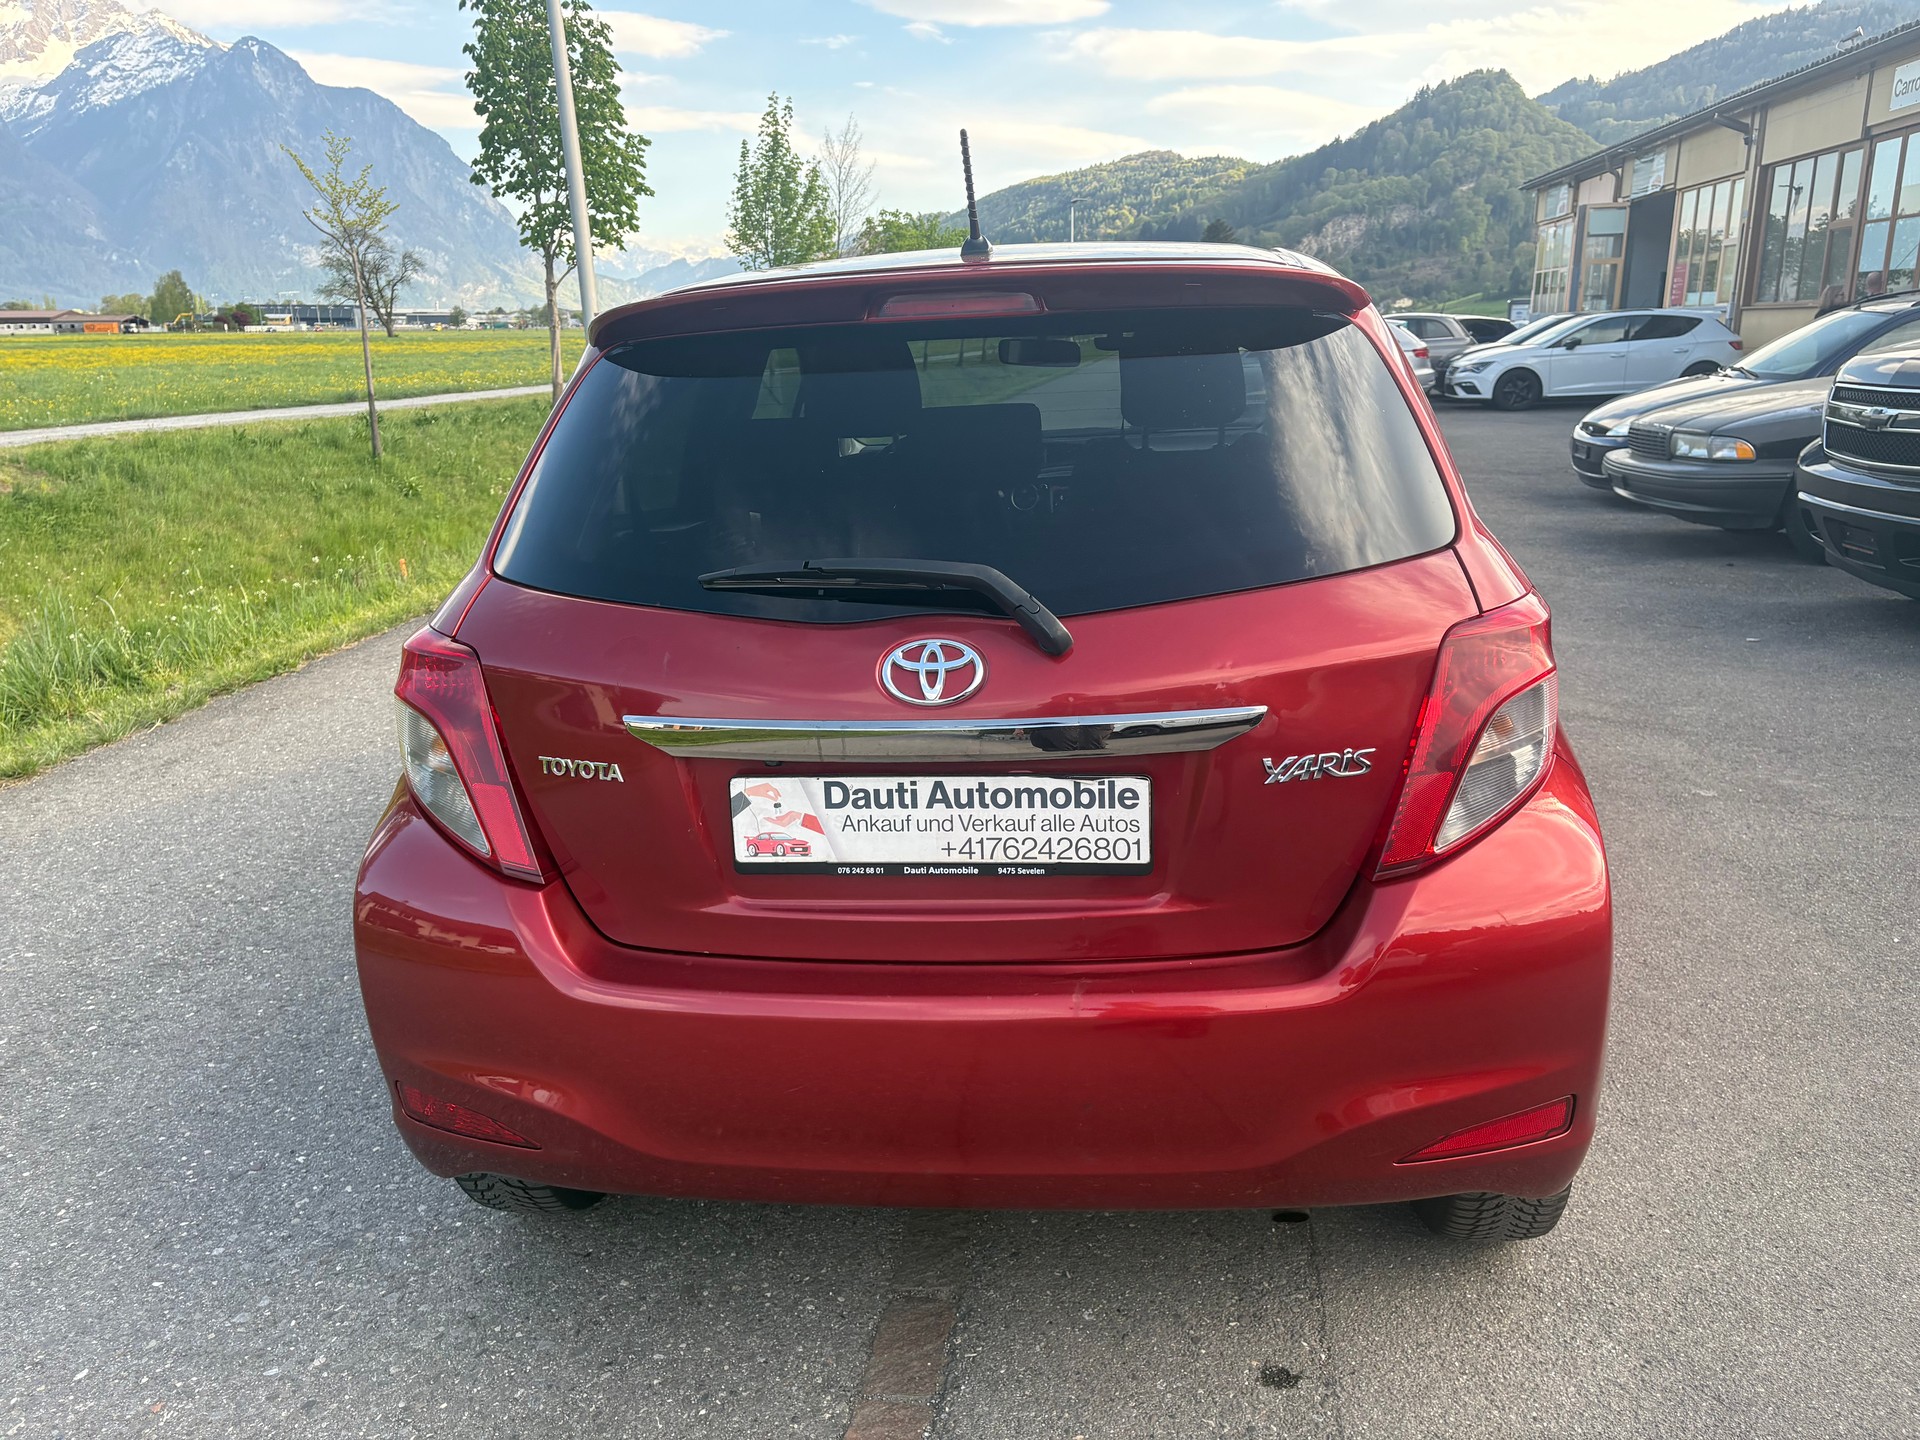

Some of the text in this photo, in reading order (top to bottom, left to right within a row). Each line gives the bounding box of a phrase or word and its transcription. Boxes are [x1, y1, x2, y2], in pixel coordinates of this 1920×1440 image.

[538, 755, 625, 783] TOYOTA
[823, 780, 1140, 810] Dauti Automobile
[841, 814, 1141, 834] Ankauf und Verkauf alle Autos
[941, 837, 1142, 861] +41762426801
[903, 866, 979, 875] Dauti Automobile
[997, 867, 1045, 875] 9475 Sevelen
